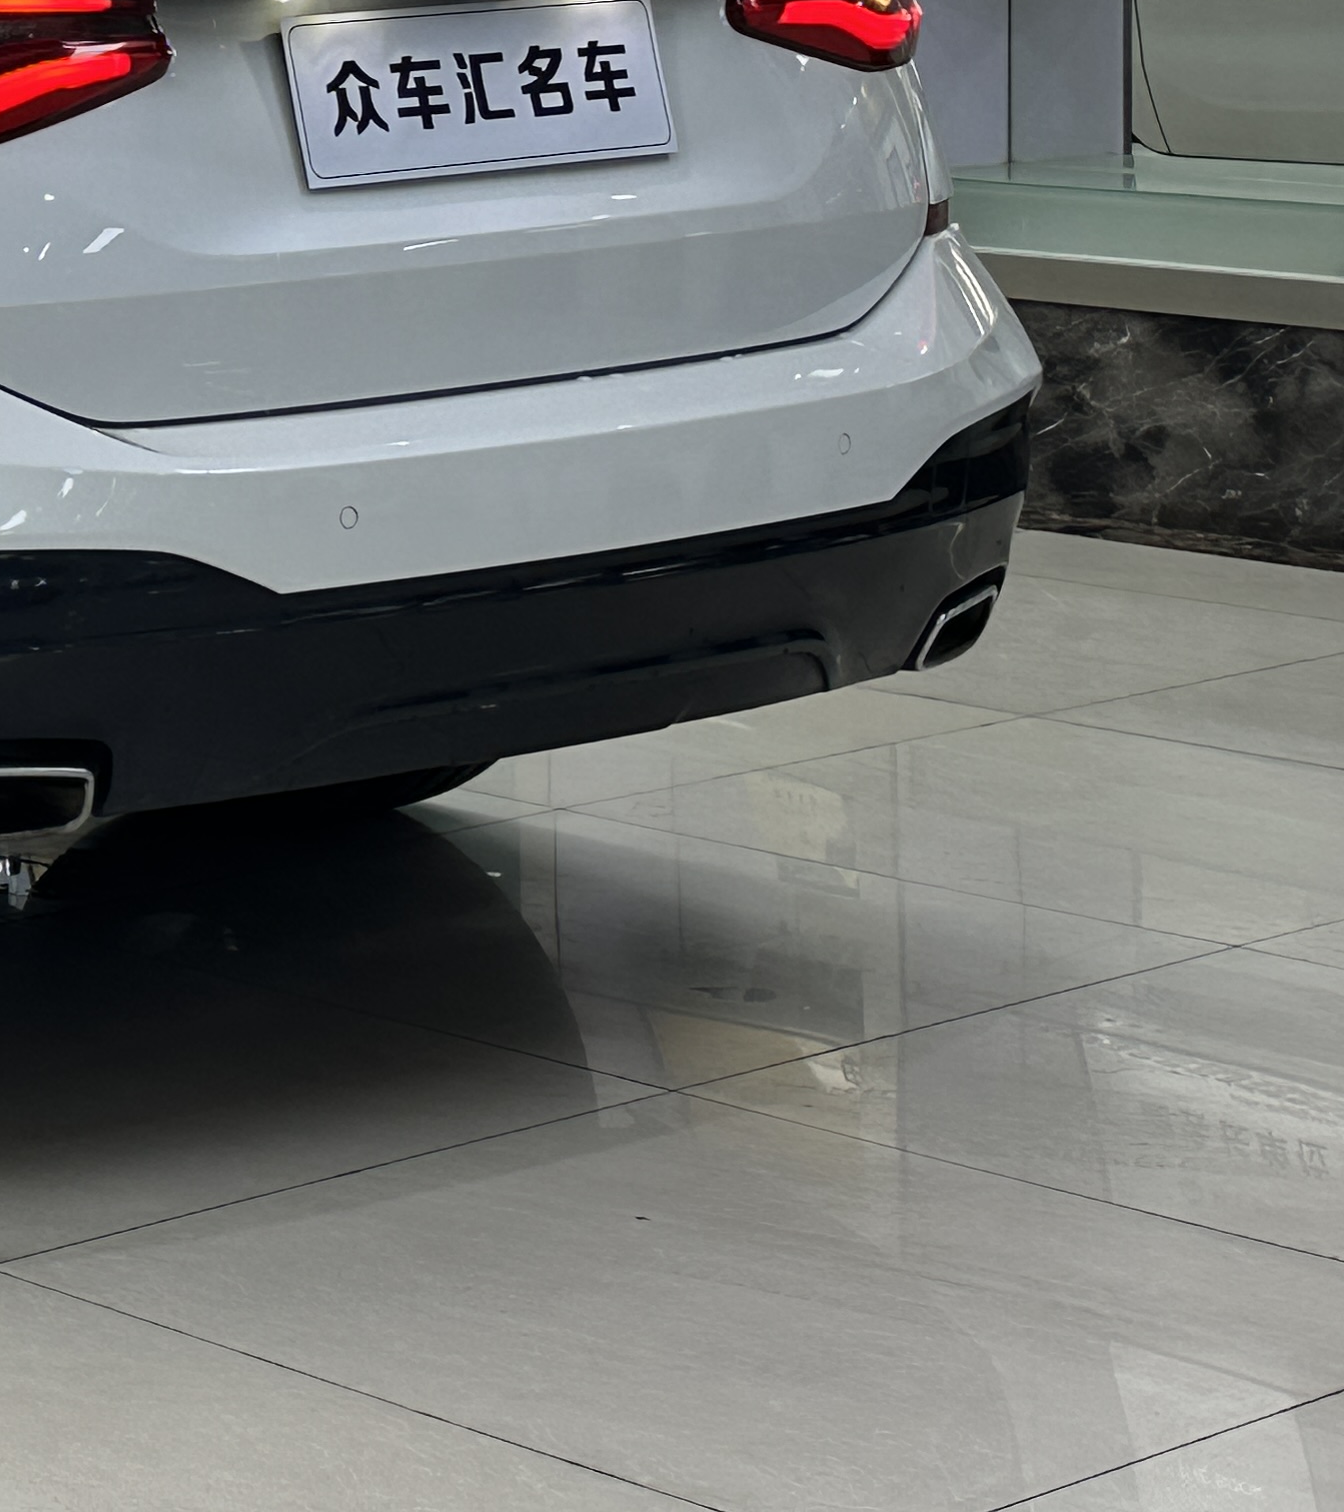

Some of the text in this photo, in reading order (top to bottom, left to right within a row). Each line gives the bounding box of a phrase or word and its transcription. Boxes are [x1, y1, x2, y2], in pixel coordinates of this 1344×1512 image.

[326, 41, 637, 138] 众车汇名车
